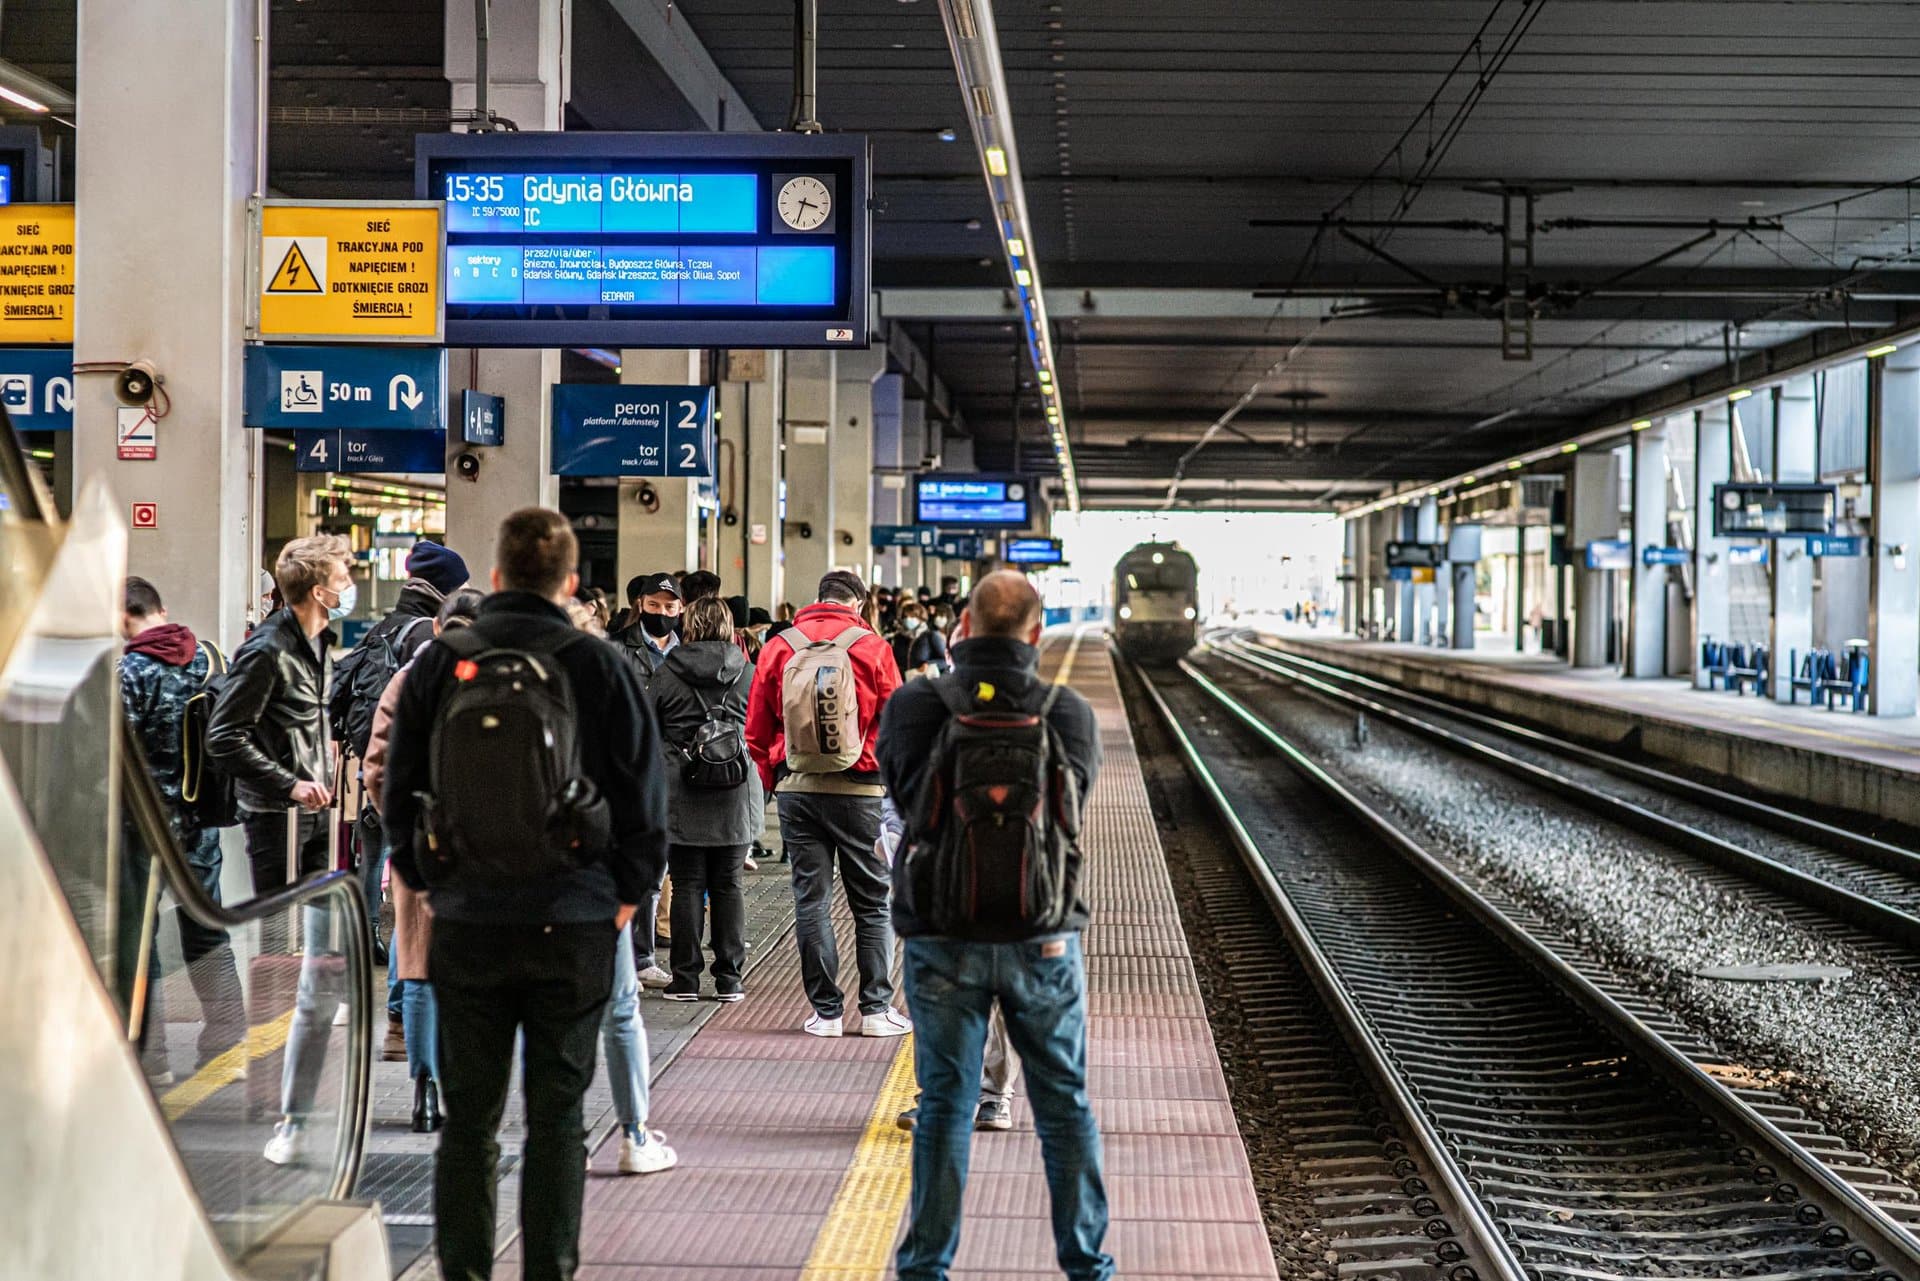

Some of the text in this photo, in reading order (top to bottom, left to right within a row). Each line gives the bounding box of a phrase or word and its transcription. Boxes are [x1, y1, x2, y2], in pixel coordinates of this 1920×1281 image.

[446, 176, 693, 204] 15:35 Gdynia Główna
[523, 208, 540, 226] IC
[17, 222, 40, 235] SIEĆ
[366, 218, 390, 232] SIEĆ
[0, 244, 72, 255] AKCYJNA POD
[337, 242, 423, 252] TRAKCYJNA POD
[467, 255, 501, 266] sektory
[609, 259, 653, 270] Bydgoszcz
[688, 259, 712, 269] Tczew
[0, 265, 57, 278] NAPIĘCIEM
[349, 262, 407, 275] NAPIĘCIEM
[717, 270, 740, 280] Sopot
[332, 282, 429, 295] DOTKNIĘCIE GROZI
[4, 302, 55, 318] ŚMIERCIĄ
[353, 299, 404, 316] ŚMIERCIĄ
[329, 383, 371, 400] 50 m
[615, 400, 697, 428] peron 2
[583, 416, 616, 427] platform
[622, 416, 659, 427] Bahnsteig
[310, 439, 328, 463] 4
[348, 441, 367, 452] tor
[622, 458, 637, 466] track
[643, 458, 659, 466] Gleis
[639, 443, 697, 468] tor 2
[819, 675, 840, 751] adida
